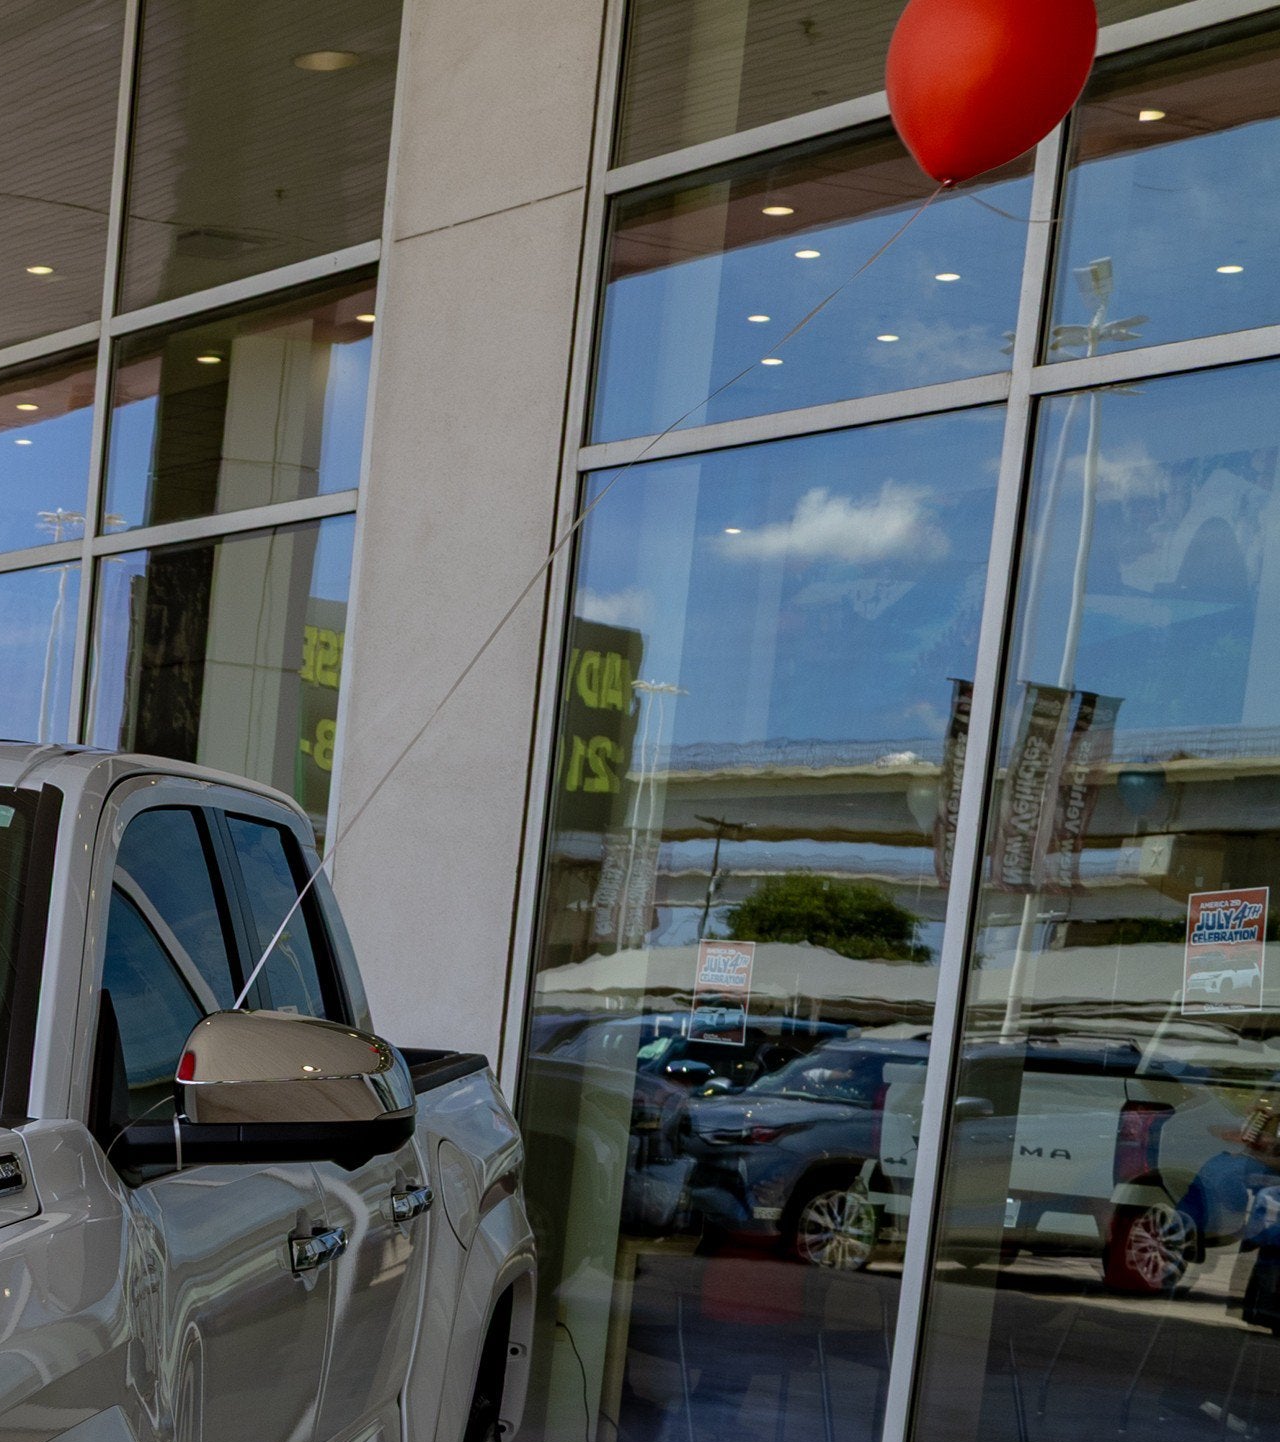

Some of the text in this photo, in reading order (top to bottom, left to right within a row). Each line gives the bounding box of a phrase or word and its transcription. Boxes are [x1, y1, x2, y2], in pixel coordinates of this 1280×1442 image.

[1200, 901, 1229, 909] AMERICA
[1195, 903, 1263, 931] JULY 4TH
[1191, 926, 1258, 945] CELEBRATION
[703, 955, 732, 973] JULY
[699, 972, 747, 986] CELEBRATION
